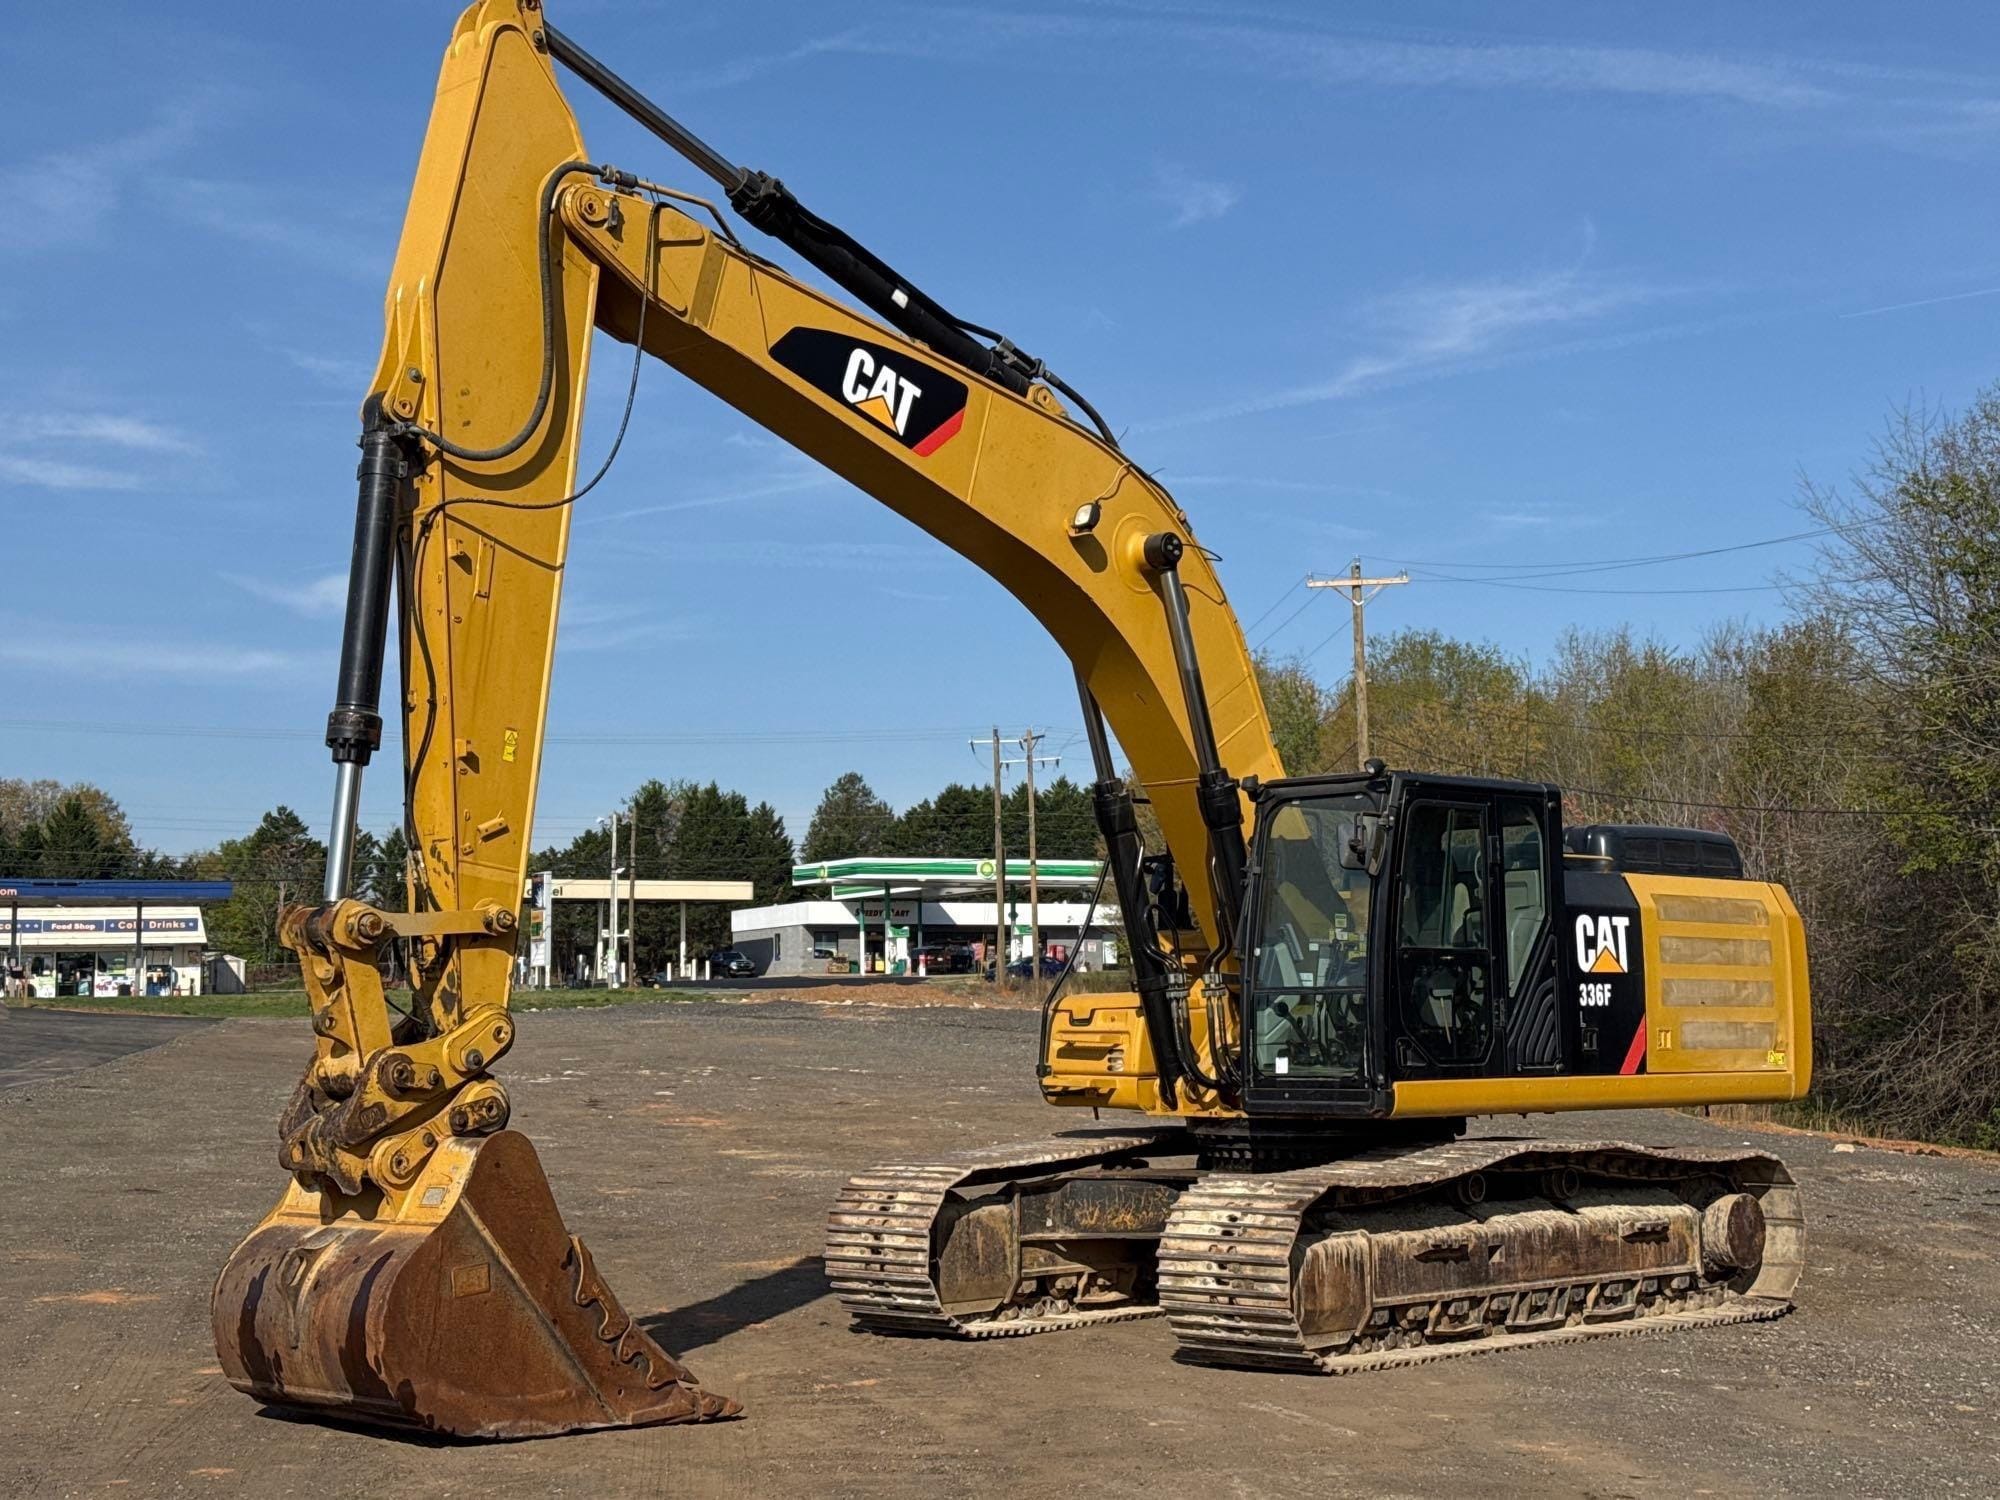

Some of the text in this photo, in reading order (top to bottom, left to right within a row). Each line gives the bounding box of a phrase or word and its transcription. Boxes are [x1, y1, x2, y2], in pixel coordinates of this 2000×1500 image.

[842, 348, 922, 437] CAT
[855, 908, 883, 917] SEEDY
[74, 923, 96, 931] Shop
[118, 920, 186, 929] Col Drinks
[1575, 914, 1630, 973] CAT
[1579, 983, 1612, 1007] 336F
